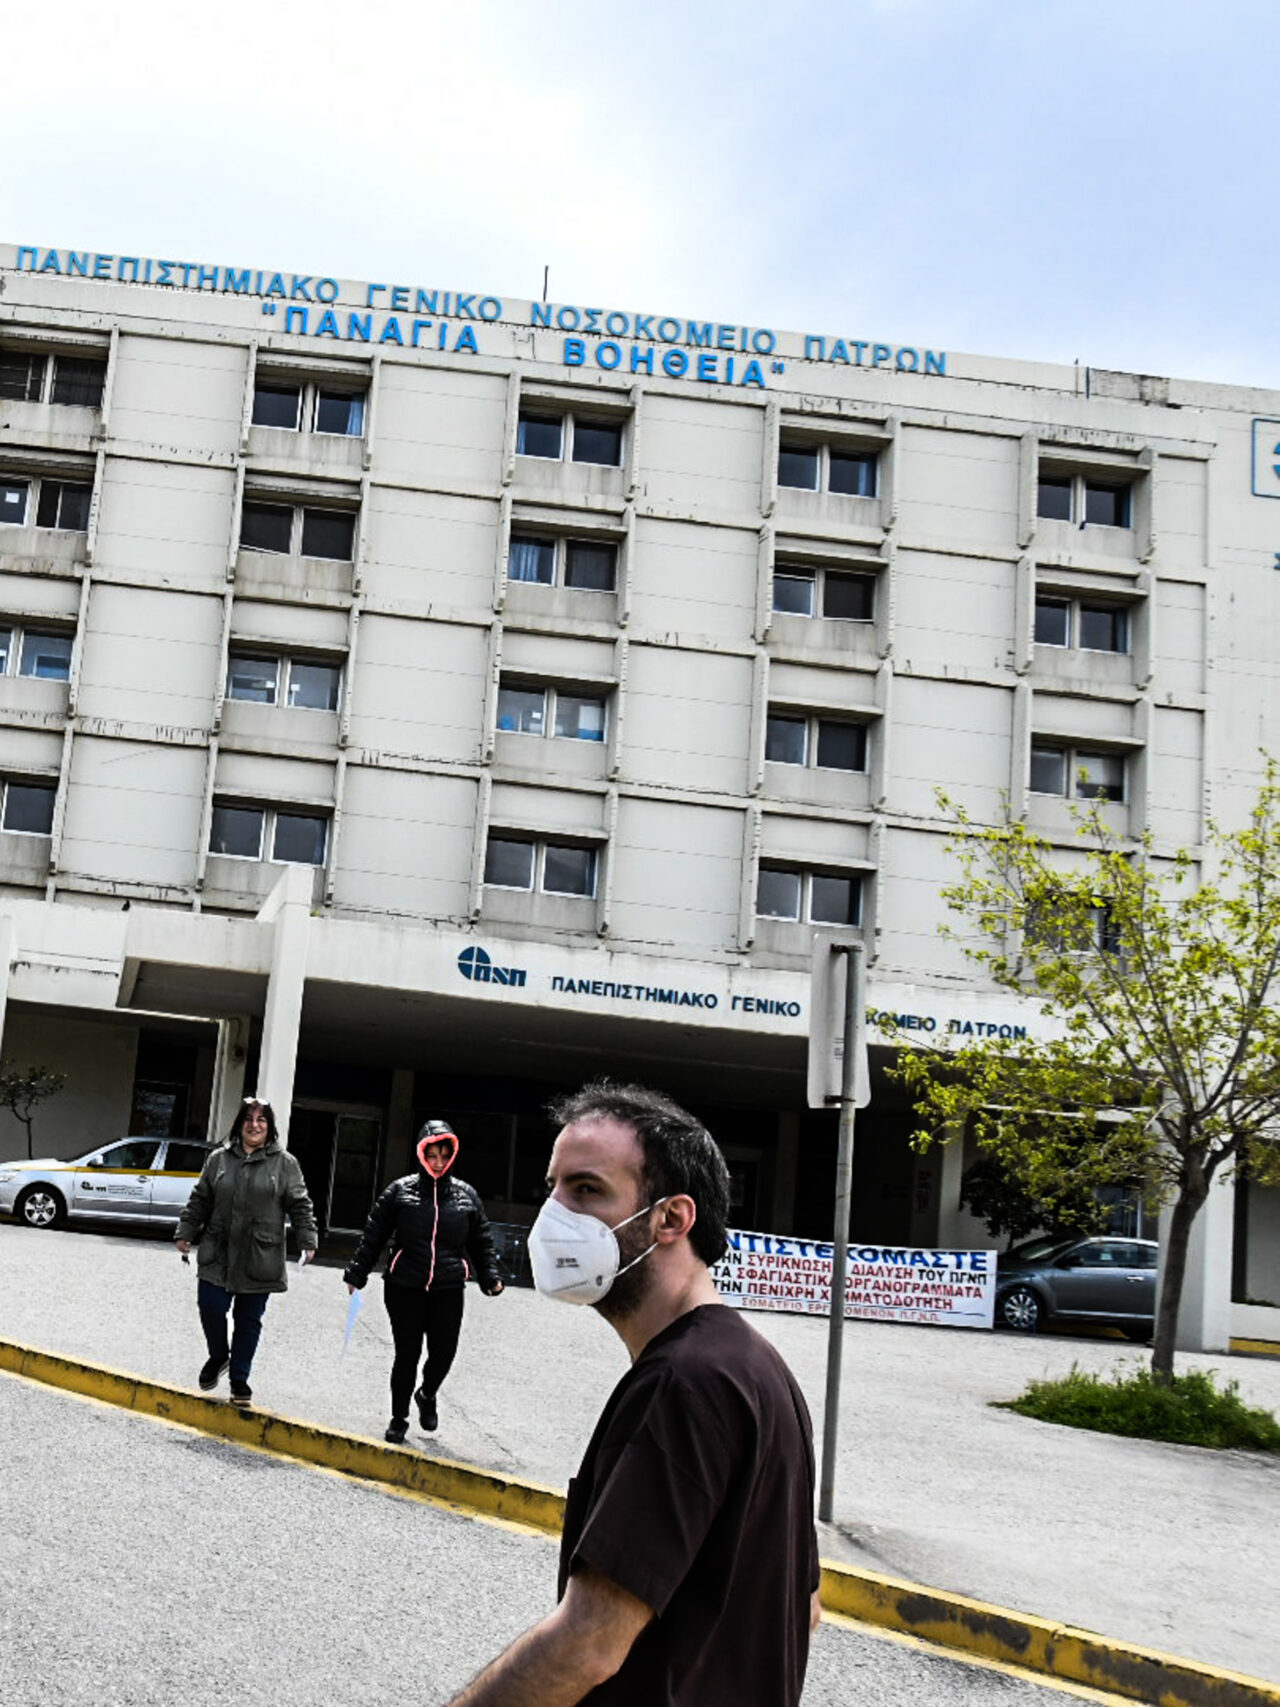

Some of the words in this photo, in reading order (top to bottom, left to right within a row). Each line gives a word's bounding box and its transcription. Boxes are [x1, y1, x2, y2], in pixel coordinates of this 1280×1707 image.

[16, 245, 339, 304] ΠΑΝΕΠΙΣΤΗΜΙΑΚΟ
[367, 283, 502, 322] ΓΕΝΙΚΟ
[531, 302, 776, 355] ΝΟΣΟΚΟΜΕΙΟ
[805, 335, 947, 376] ΠΑΤΡΩΝ
[262, 302, 479, 354] "ΠΑΝΑΓΙΑ
[564, 337, 784, 388] ΒΟΗΘΕΙΑ"
[551, 976, 718, 1009] ΠΑΝΕΠΙΣΤΗΜΙΑΚΟ
[731, 995, 801, 1017] ΓΕΝΙΚΟ
[866, 1011, 936, 1033] ΚΟΜΕΙΟ
[949, 1018, 1027, 1040] ΠΑΤΡΩΝ
[722, 1252, 742, 1265] ΗΝ
[851, 1263, 913, 1279] ΔΙΑΛΥΣΗ
[918, 1269, 946, 1283] ΤΟΥ
[726, 1232, 987, 1271] ΝΤΙΣΤΕΚΟΜΑΣΤΕ
[748, 1282, 815, 1299] ΠΕΝΙΧΡΗ
[821, 1289, 953, 1310] ΧΗΜΑΤΟΔΟΤΗΣΗ
